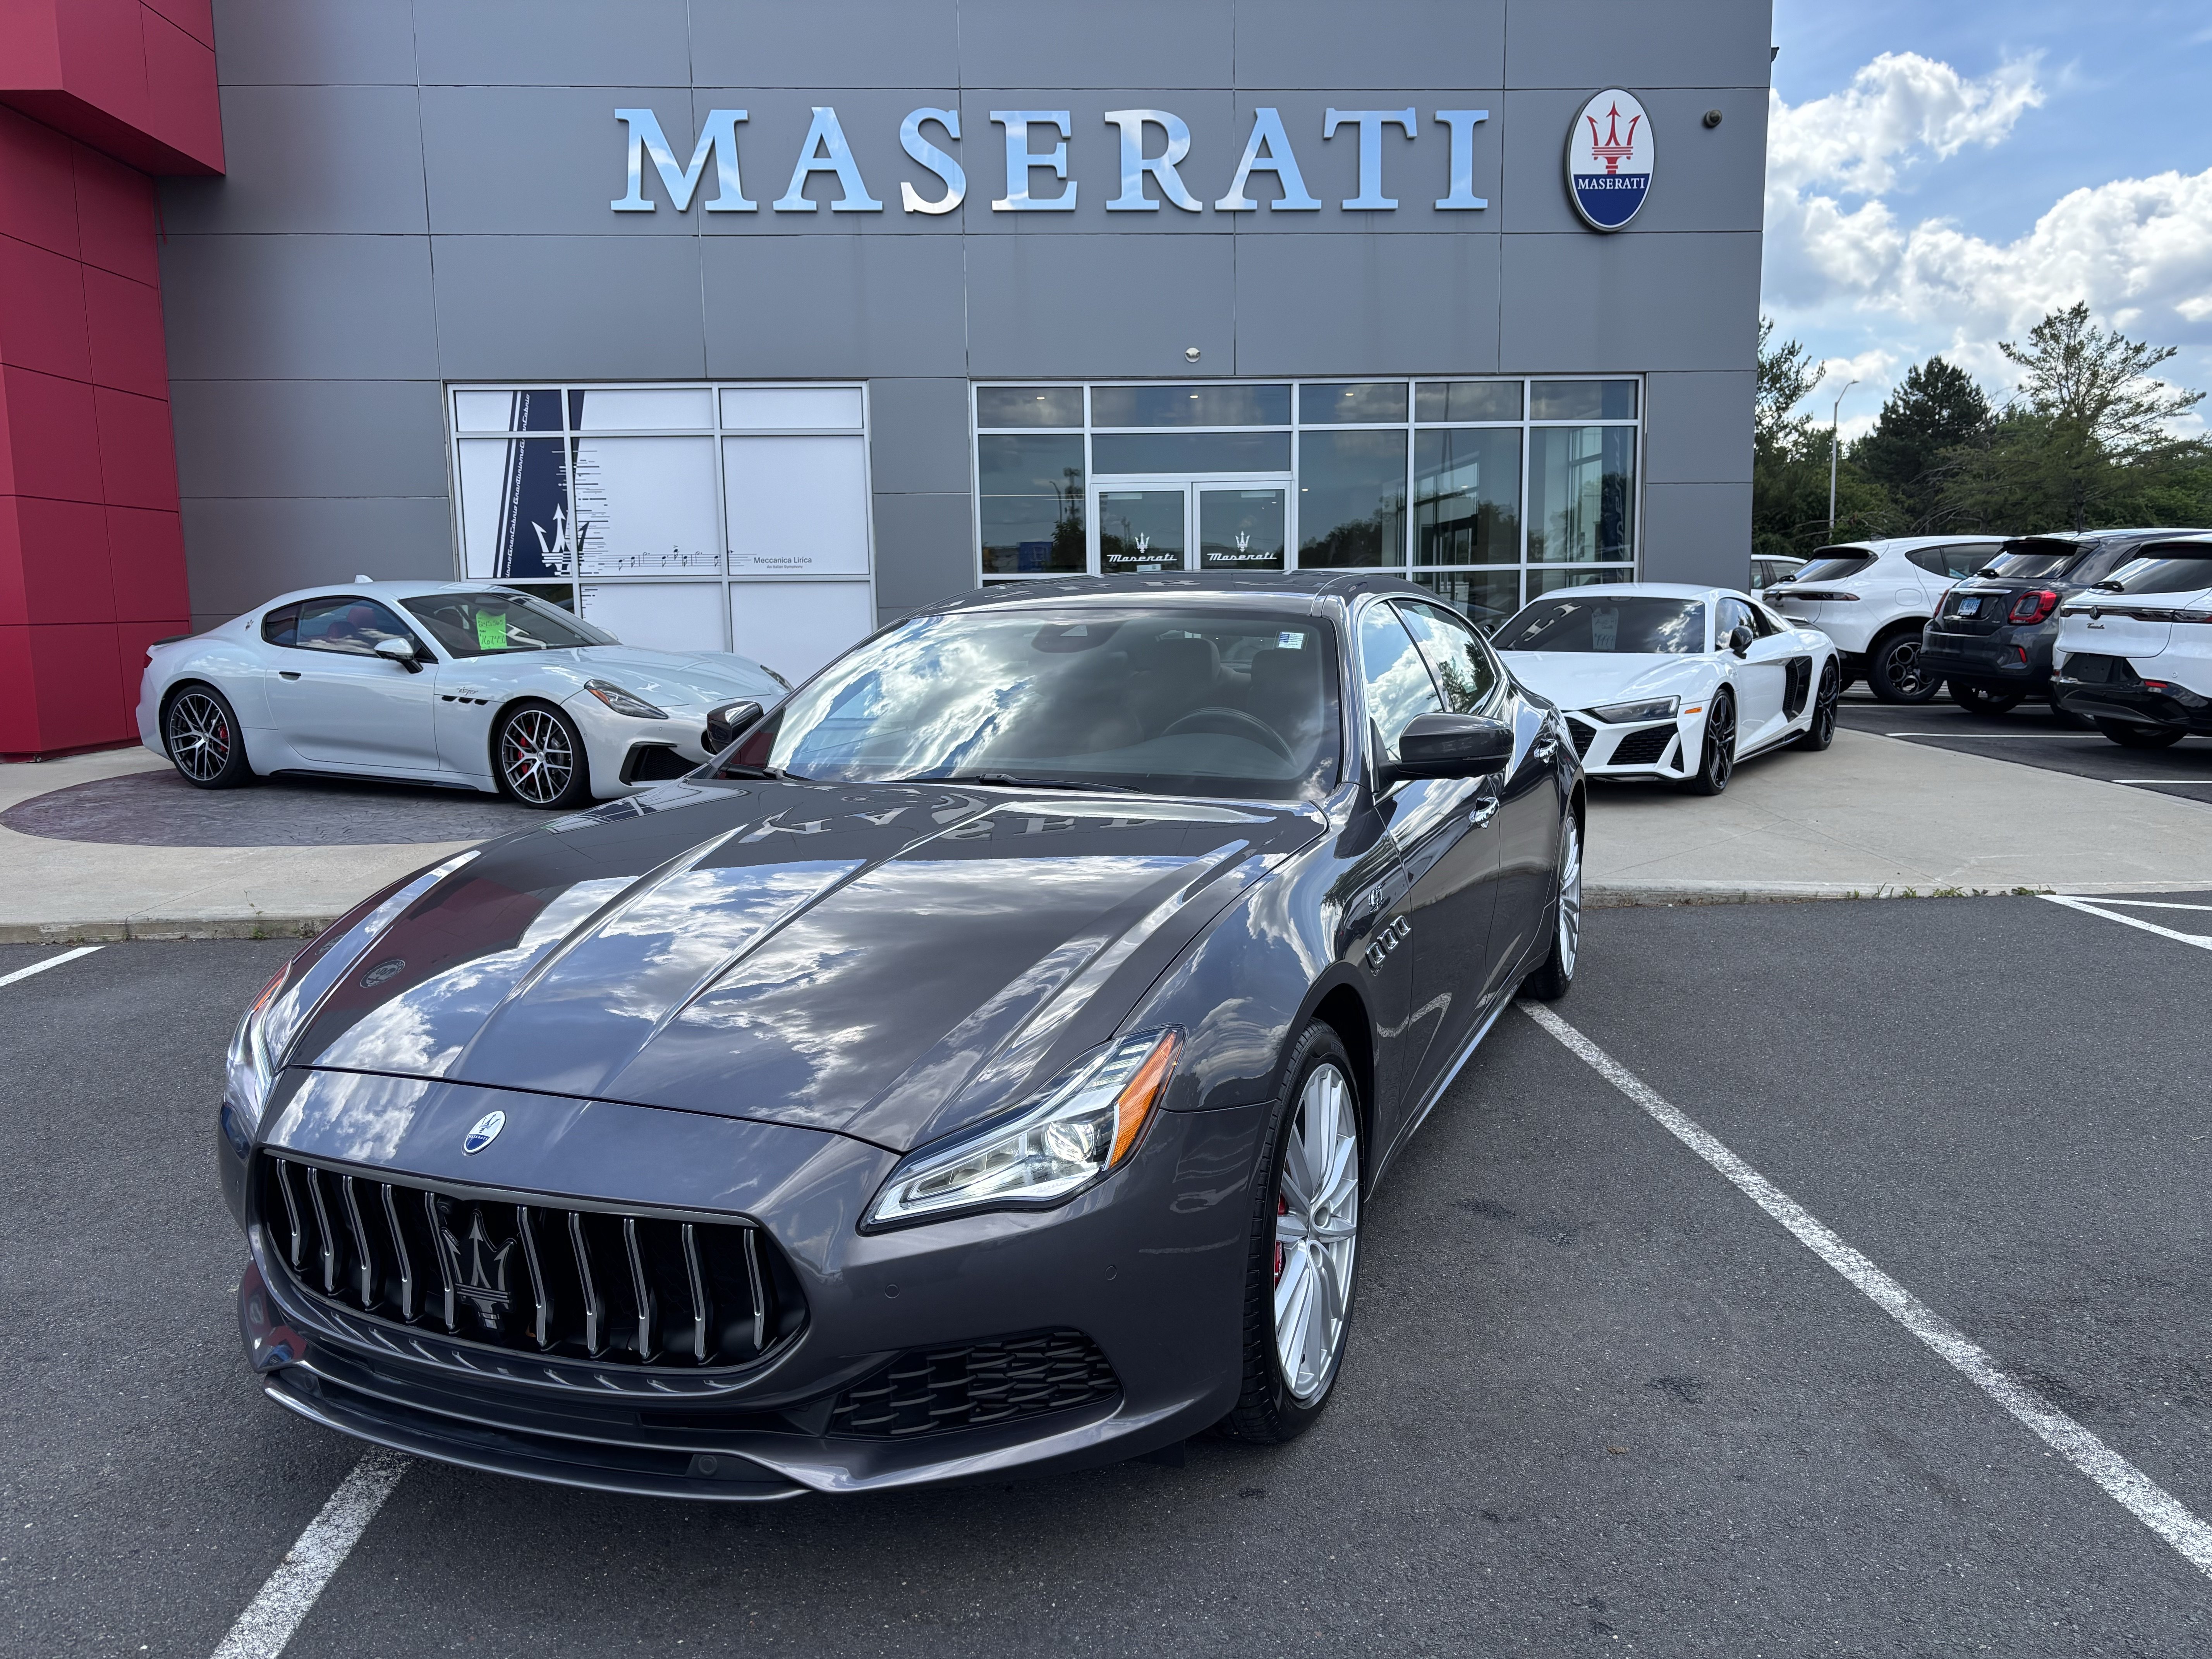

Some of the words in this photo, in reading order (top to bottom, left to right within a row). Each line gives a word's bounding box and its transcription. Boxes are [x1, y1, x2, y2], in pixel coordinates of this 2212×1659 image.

[610, 106, 1489, 215] MASERATI
[1577, 178, 1645, 190] MASERATI
[1106, 553, 1178, 562] Maserati
[1207, 551, 1277, 561] Maserati
